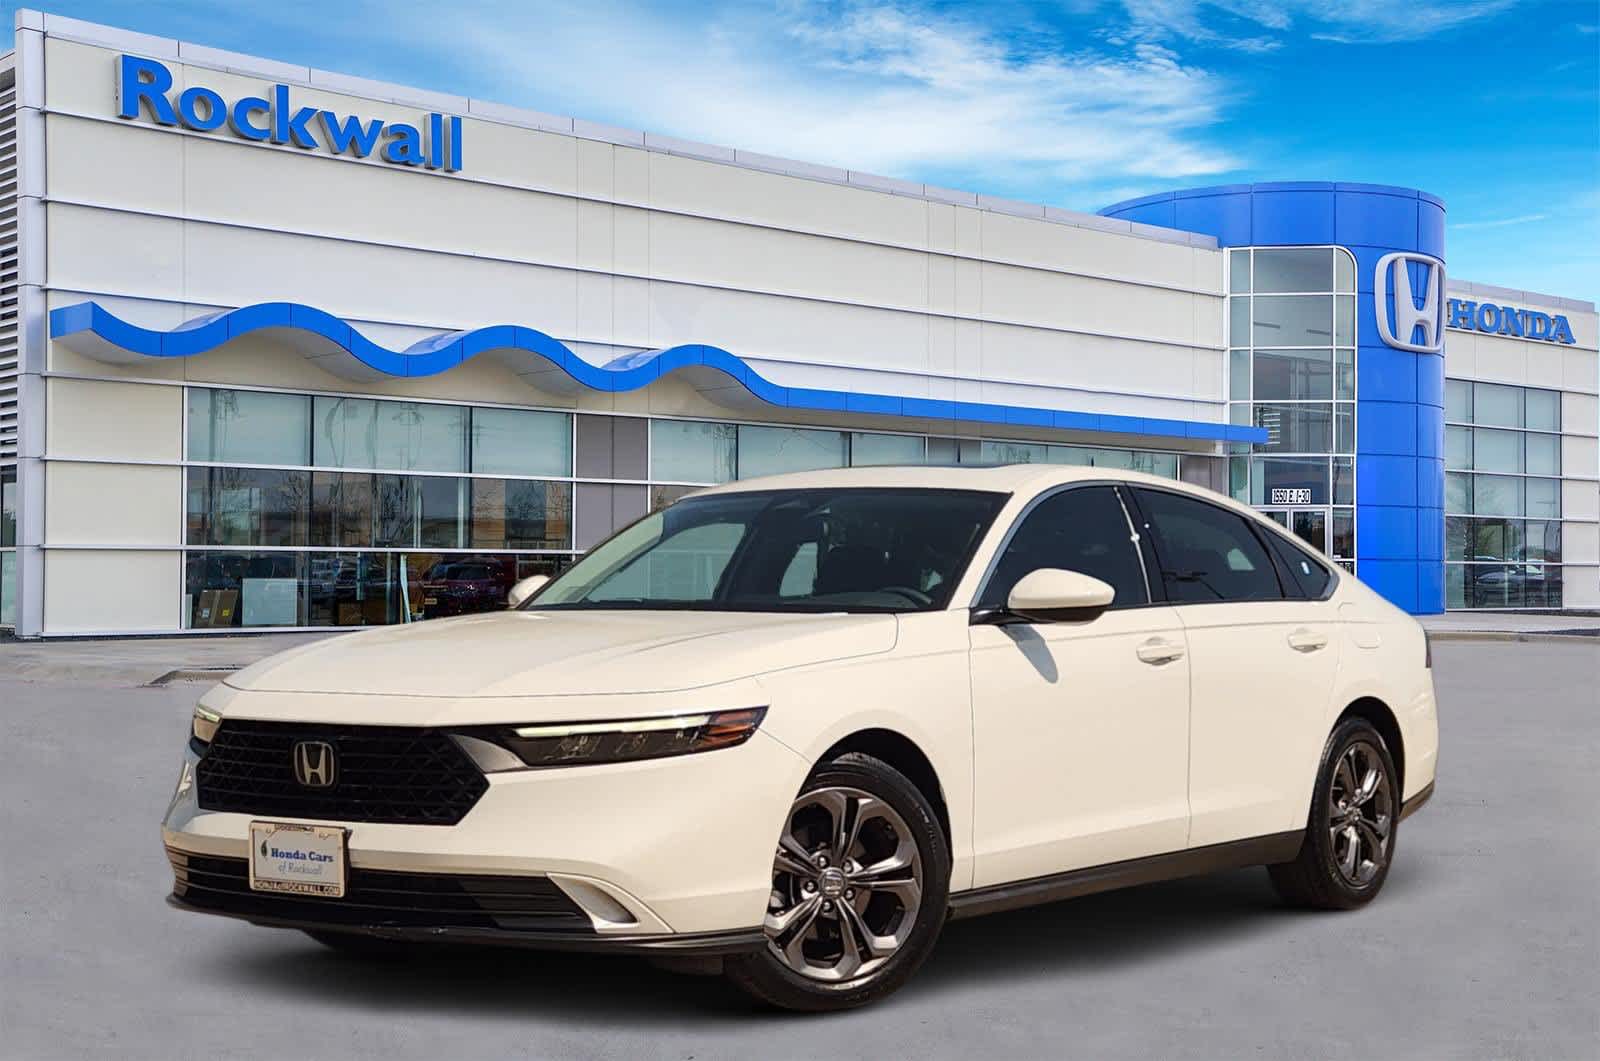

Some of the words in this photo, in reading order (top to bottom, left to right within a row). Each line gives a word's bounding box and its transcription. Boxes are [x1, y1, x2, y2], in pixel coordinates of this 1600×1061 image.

[118, 54, 463, 172] Rockwall
[1447, 298, 1577, 344] HONDA
[271, 848, 306, 861] Honda
[308, 851, 334, 862] Cars
